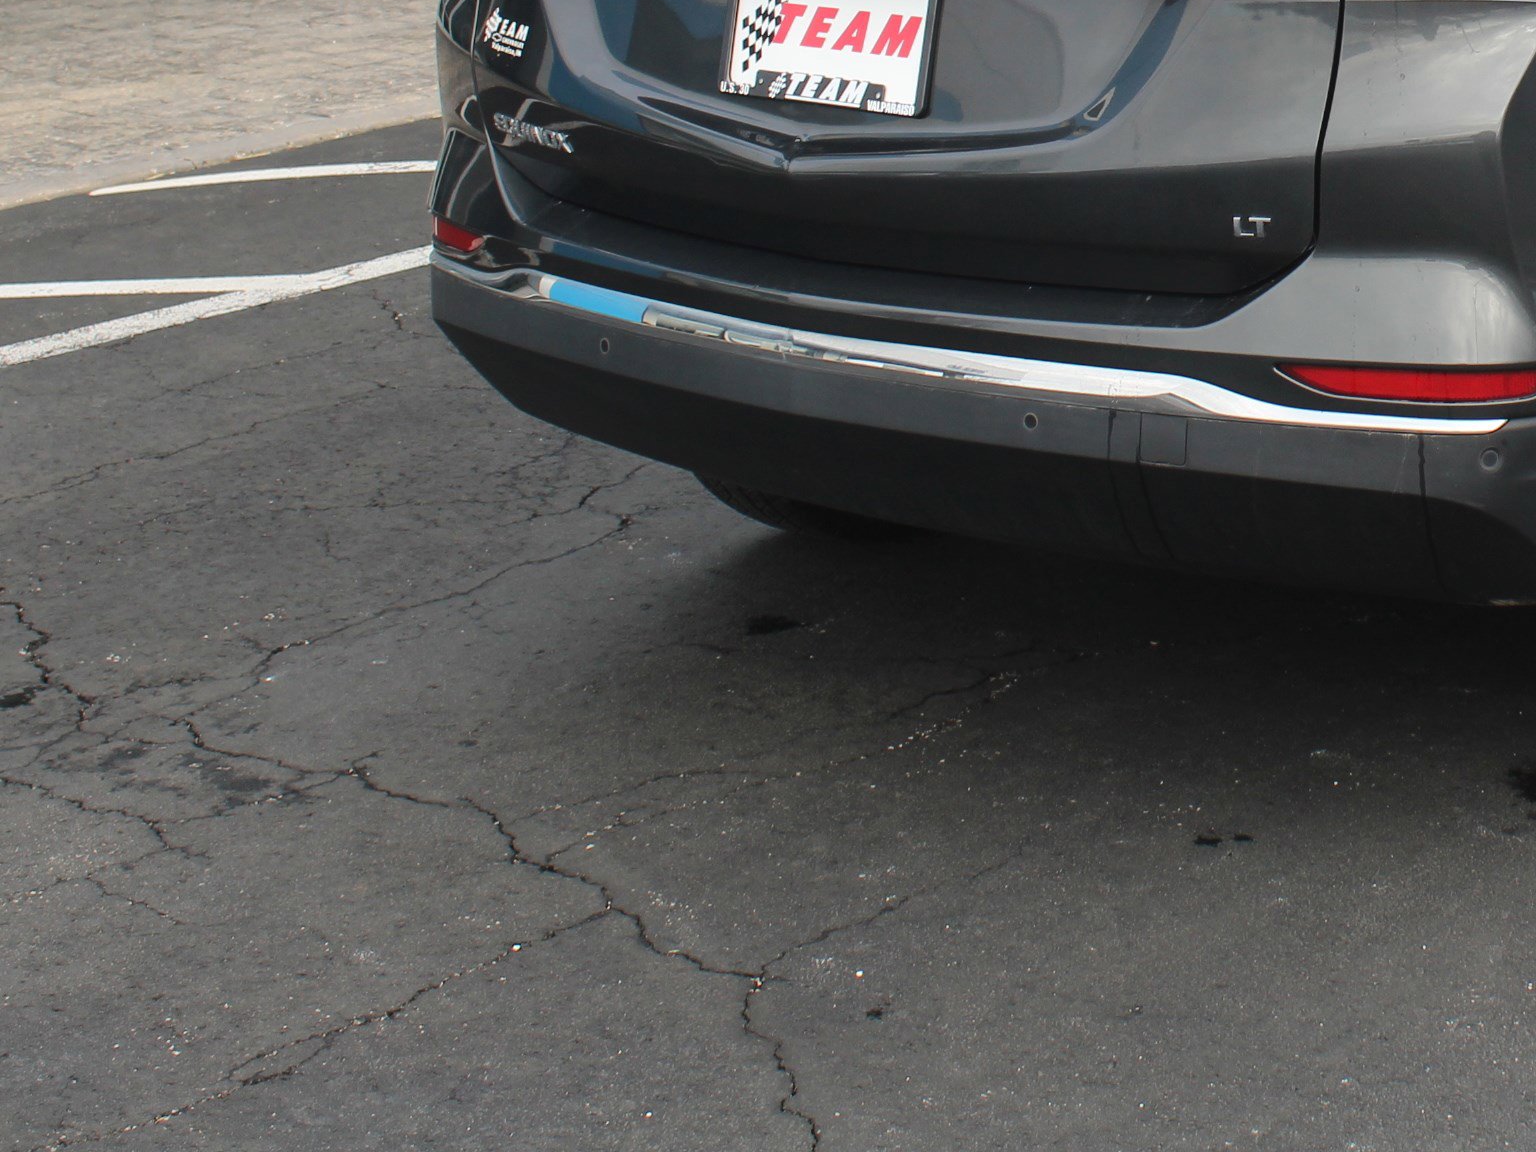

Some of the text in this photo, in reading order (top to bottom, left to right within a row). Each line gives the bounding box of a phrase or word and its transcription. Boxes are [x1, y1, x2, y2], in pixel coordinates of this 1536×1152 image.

[772, 2, 923, 58] TEAM
[720, 80, 750, 96] U.S. 30
[785, 72, 870, 104] TEAM
[866, 99, 915, 117] VALPARAISO
[1233, 216, 1272, 238] LT
